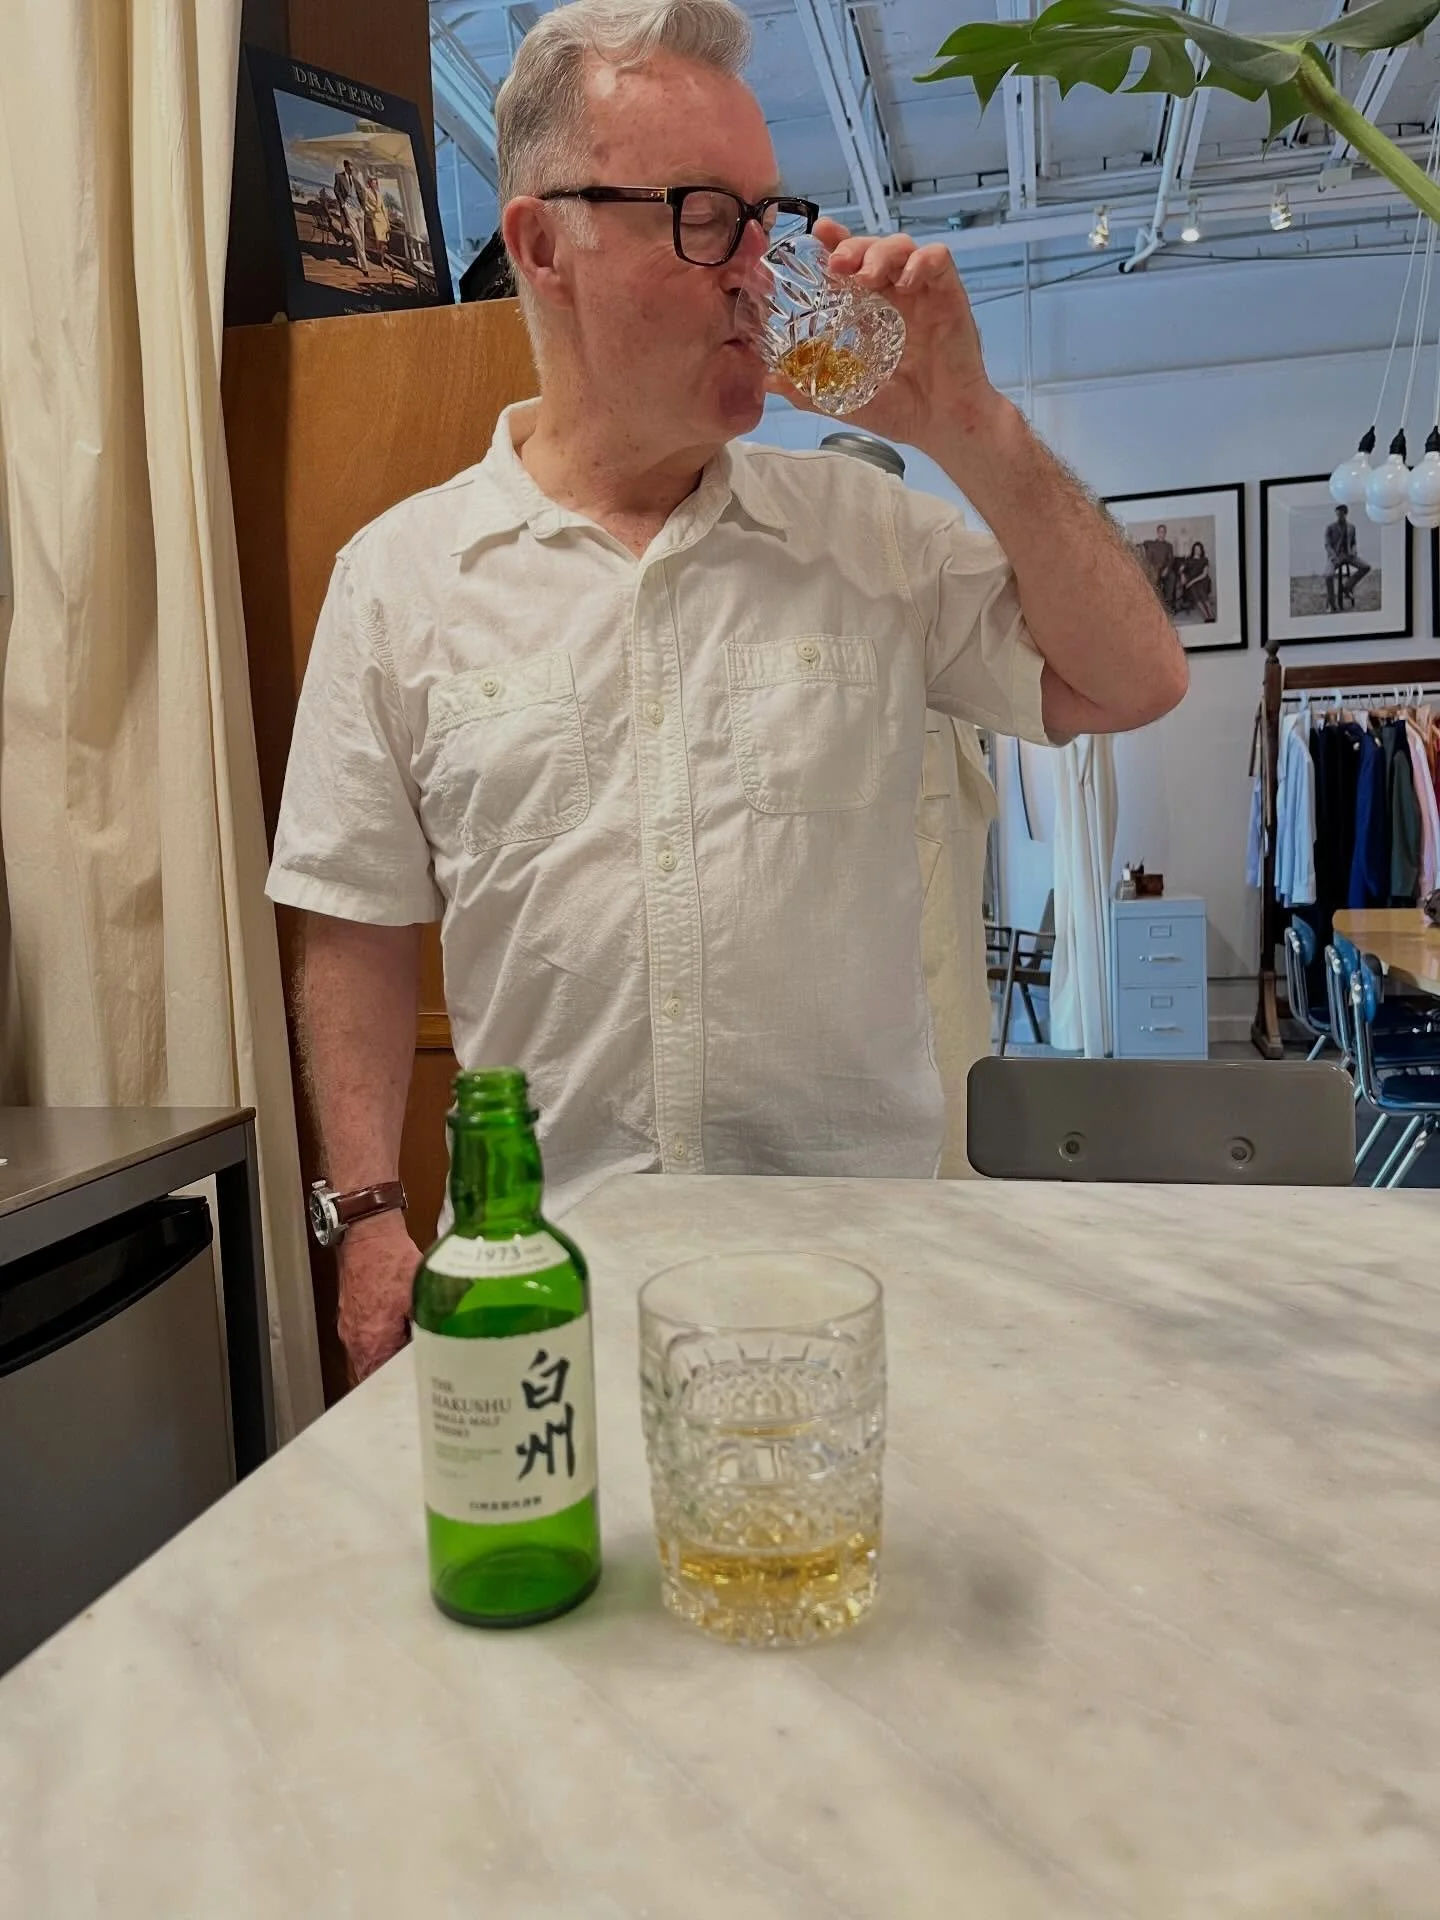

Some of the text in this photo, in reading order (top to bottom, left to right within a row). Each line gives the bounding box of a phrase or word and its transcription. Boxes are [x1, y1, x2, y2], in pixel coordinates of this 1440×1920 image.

[291, 65, 385, 112] DRAPERS
[475, 1244, 521, 1261] 1973
[432, 1392, 512, 1414] HAKUSHU
[515, 1349, 575, 1480] 白州
